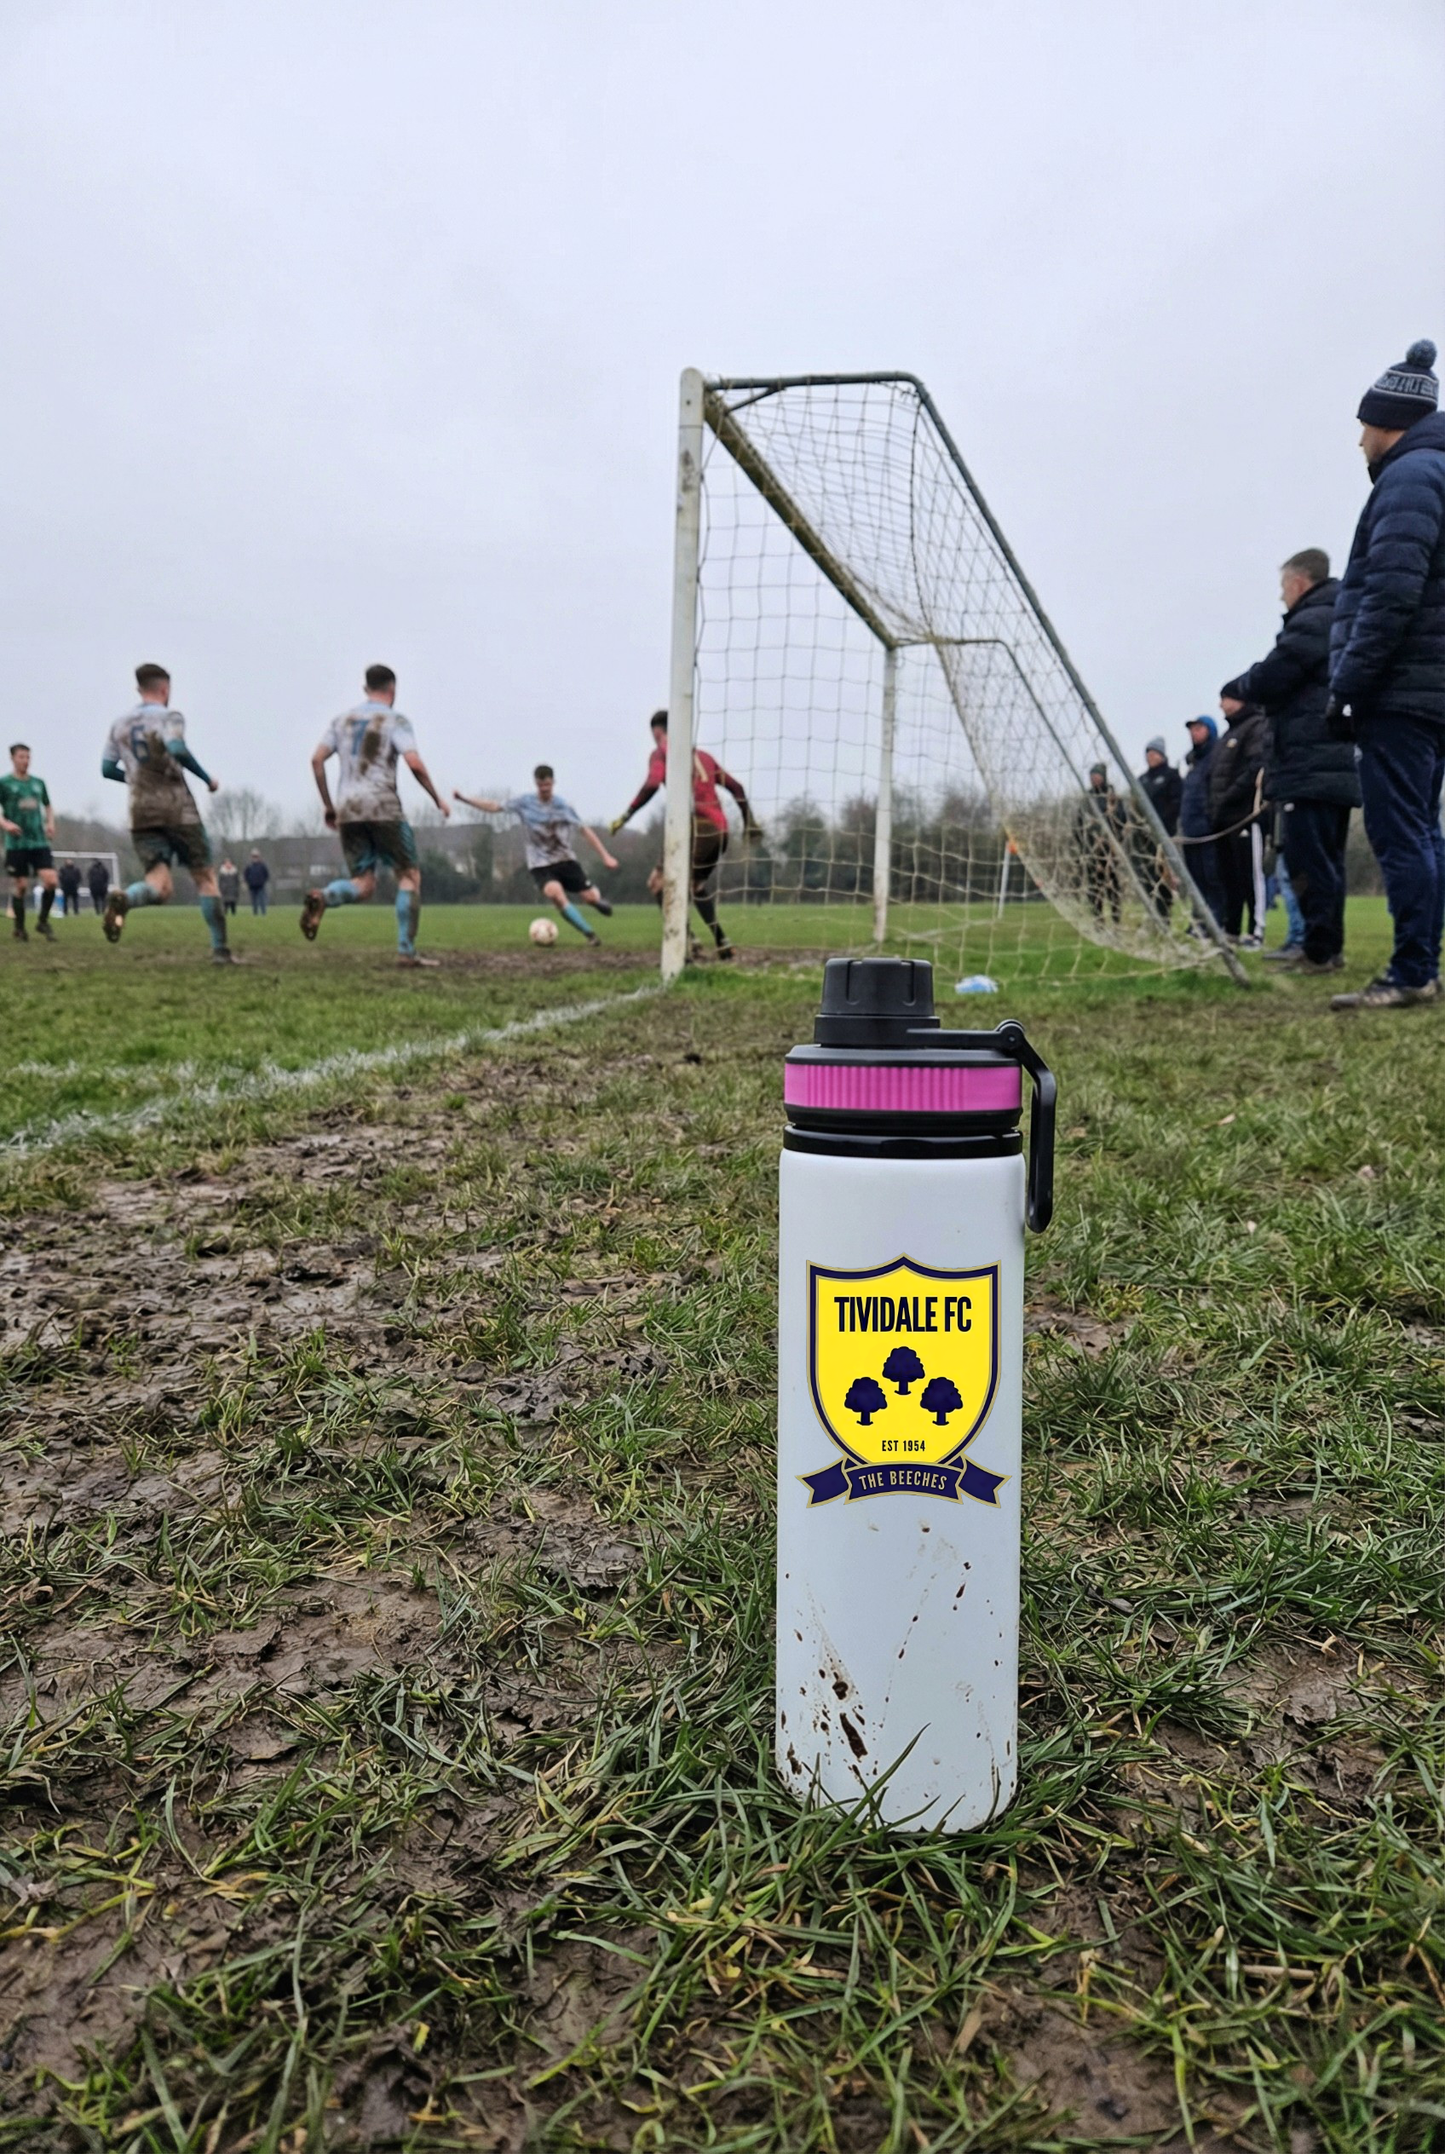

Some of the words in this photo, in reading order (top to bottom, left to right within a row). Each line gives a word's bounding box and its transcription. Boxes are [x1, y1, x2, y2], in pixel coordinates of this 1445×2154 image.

[131, 724, 150, 763] 6
[834, 1296, 938, 1332] TIVIDALE
[944, 1296, 972, 1332] FC
[882, 1440, 898, 1451] EST
[903, 1440, 925, 1451] 1954
[858, 1471, 884, 1490] THE
[889, 1470, 947, 1490] BEECHES
